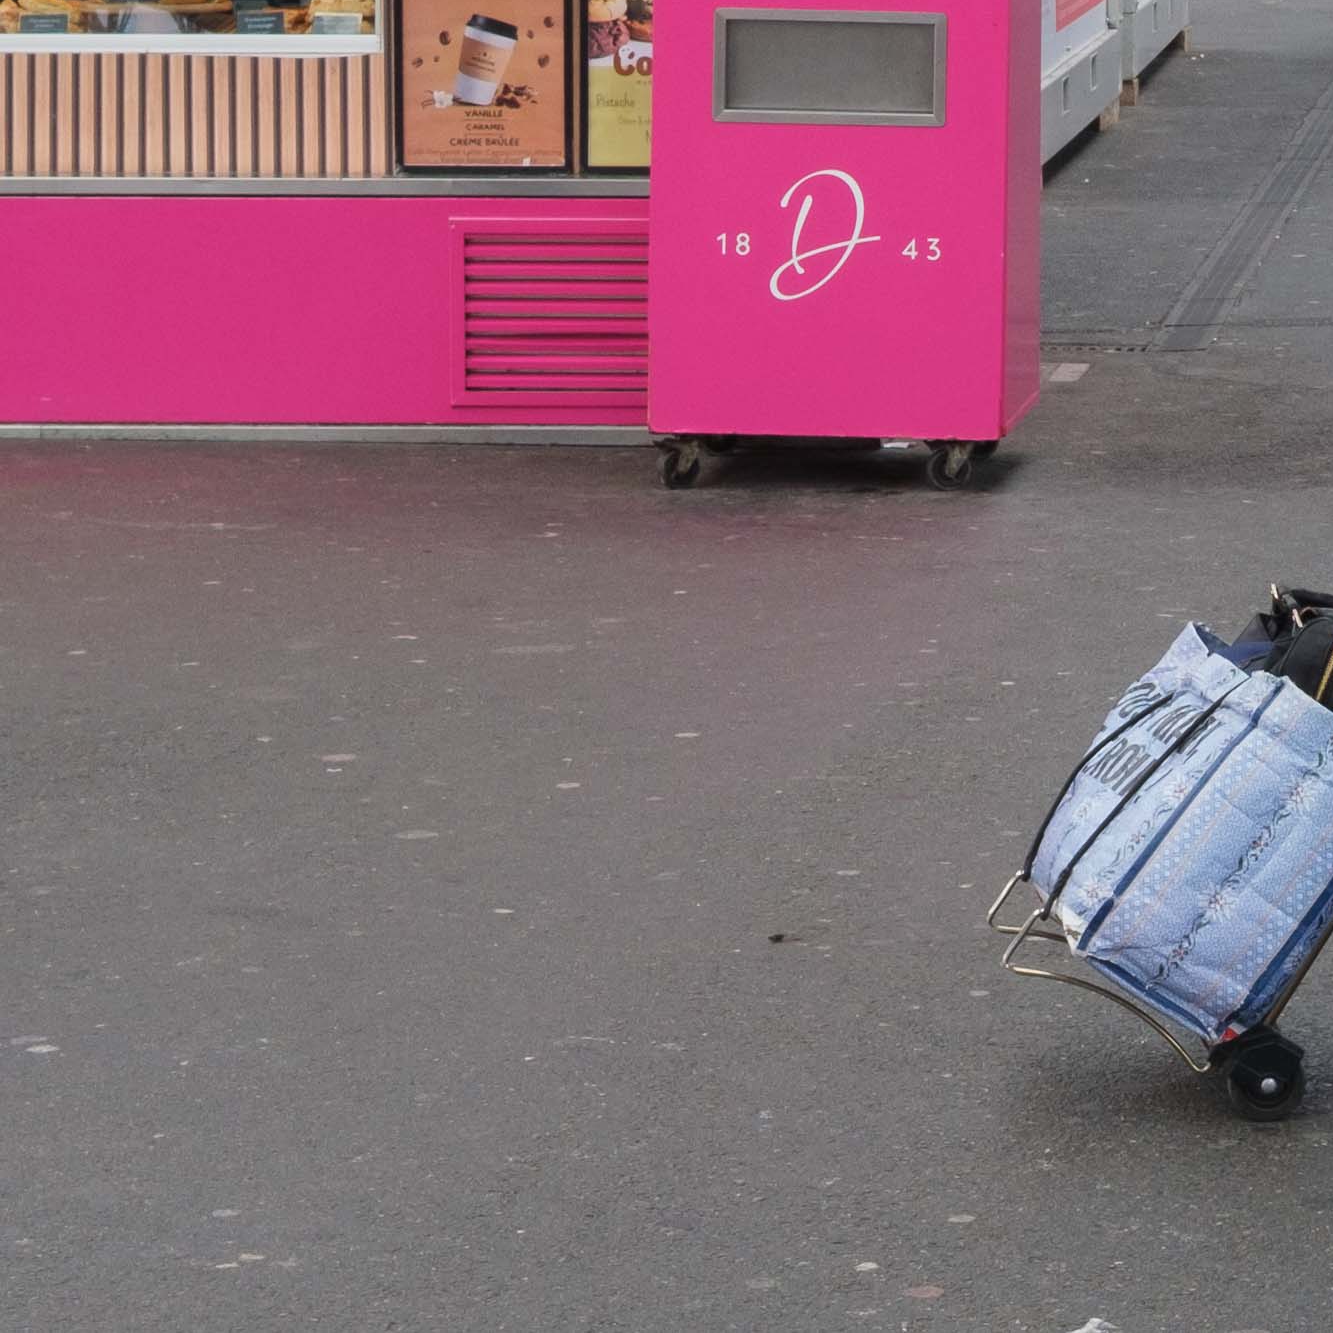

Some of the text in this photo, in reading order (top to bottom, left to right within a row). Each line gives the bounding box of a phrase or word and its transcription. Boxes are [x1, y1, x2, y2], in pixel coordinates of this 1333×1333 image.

[464, 109, 503, 117] VANILLE
[716, 170, 941, 300] 18 D 43
